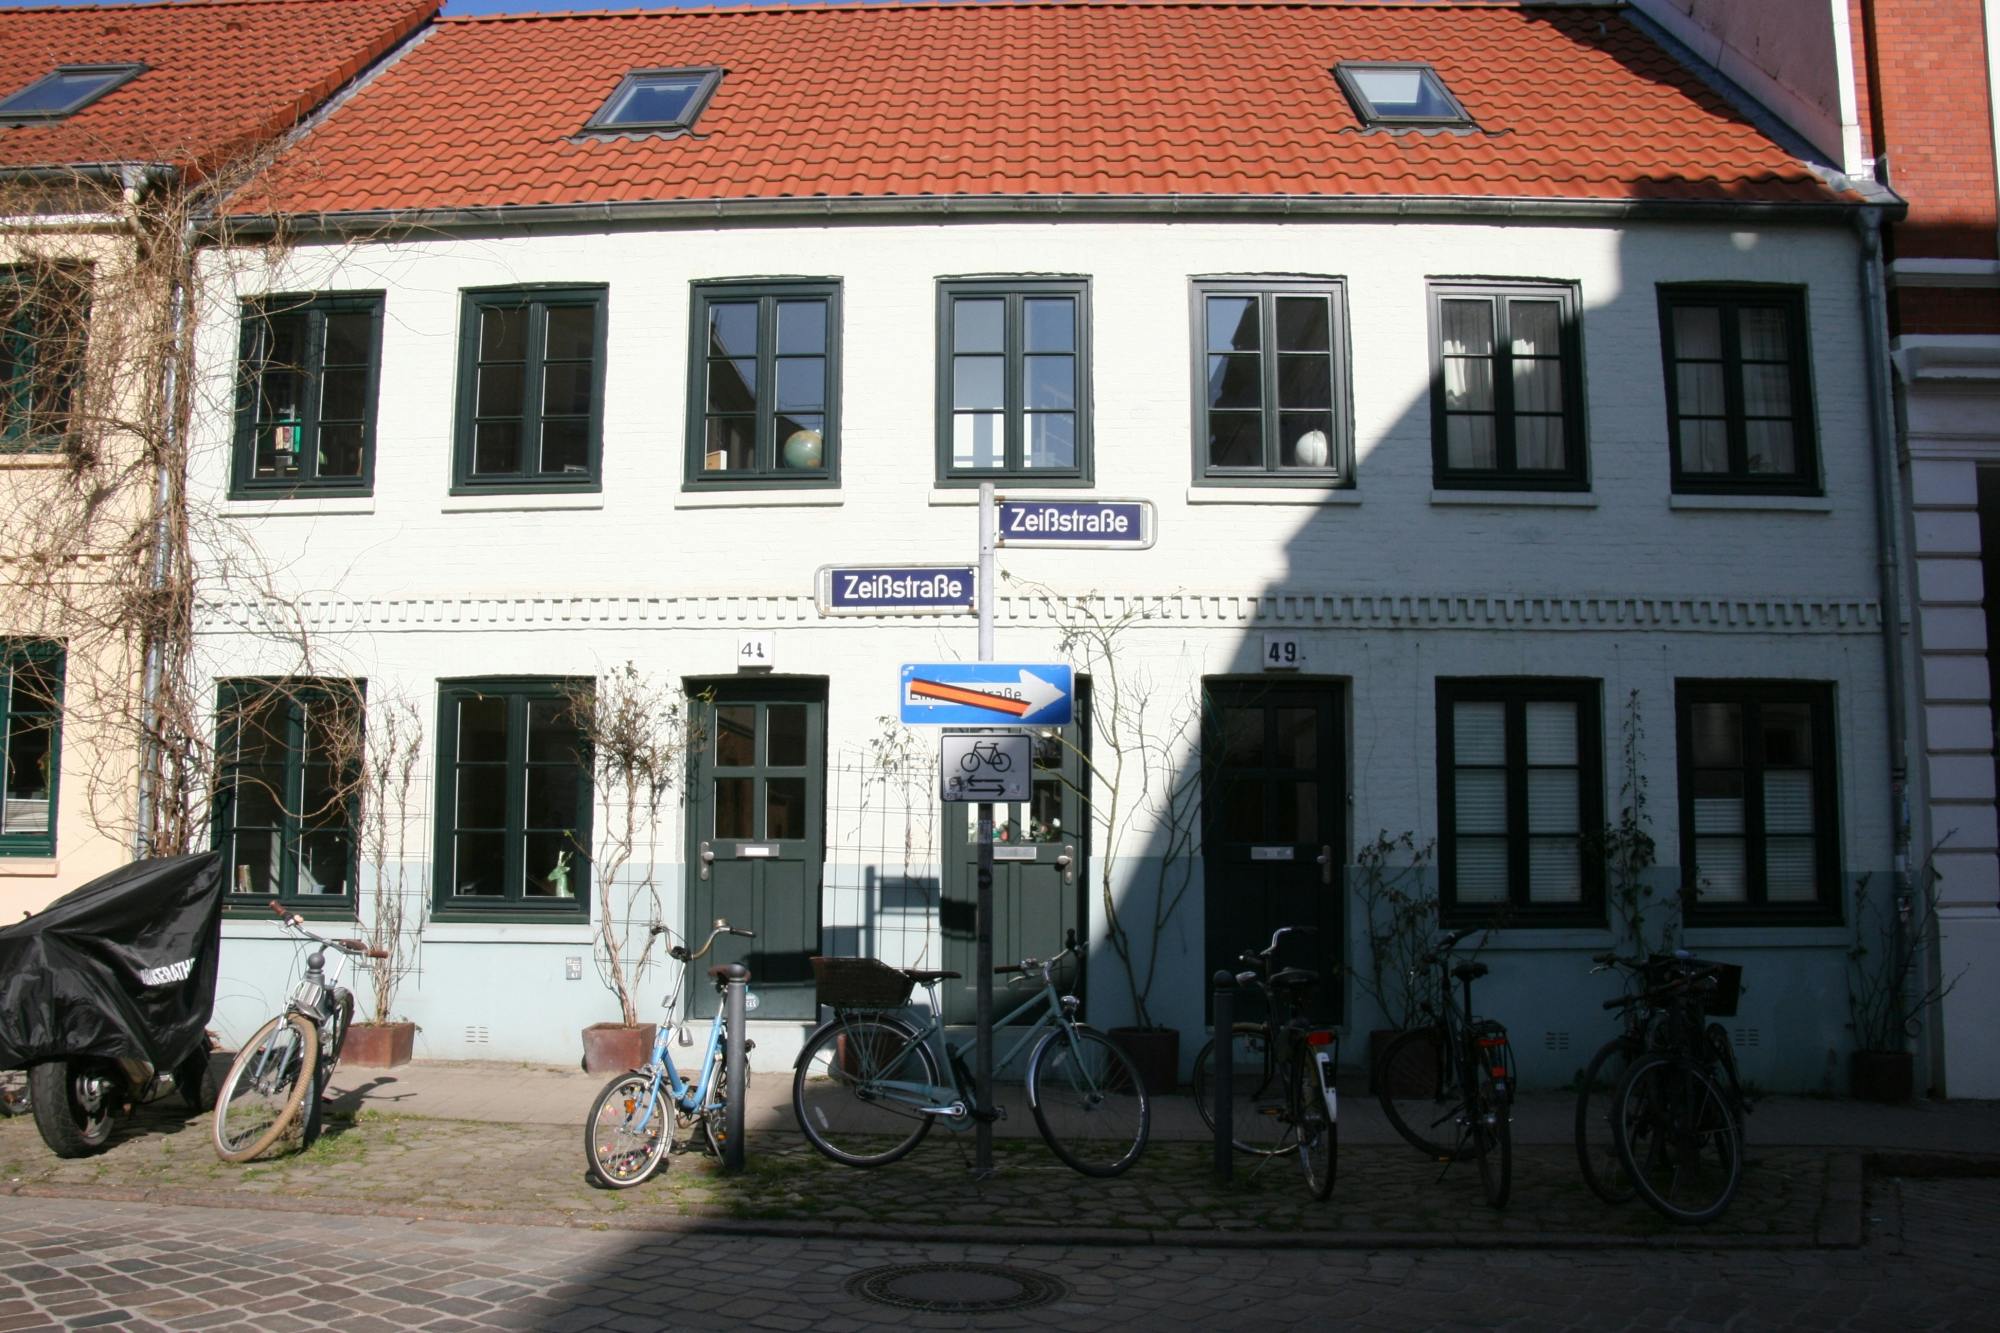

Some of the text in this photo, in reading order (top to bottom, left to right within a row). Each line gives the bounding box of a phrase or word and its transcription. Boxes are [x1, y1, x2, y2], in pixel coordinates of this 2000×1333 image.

[1010, 508, 1129, 533] Zeißstraße
[843, 574, 962, 599] Zeißstraße
[1269, 641, 1296, 662] 49
